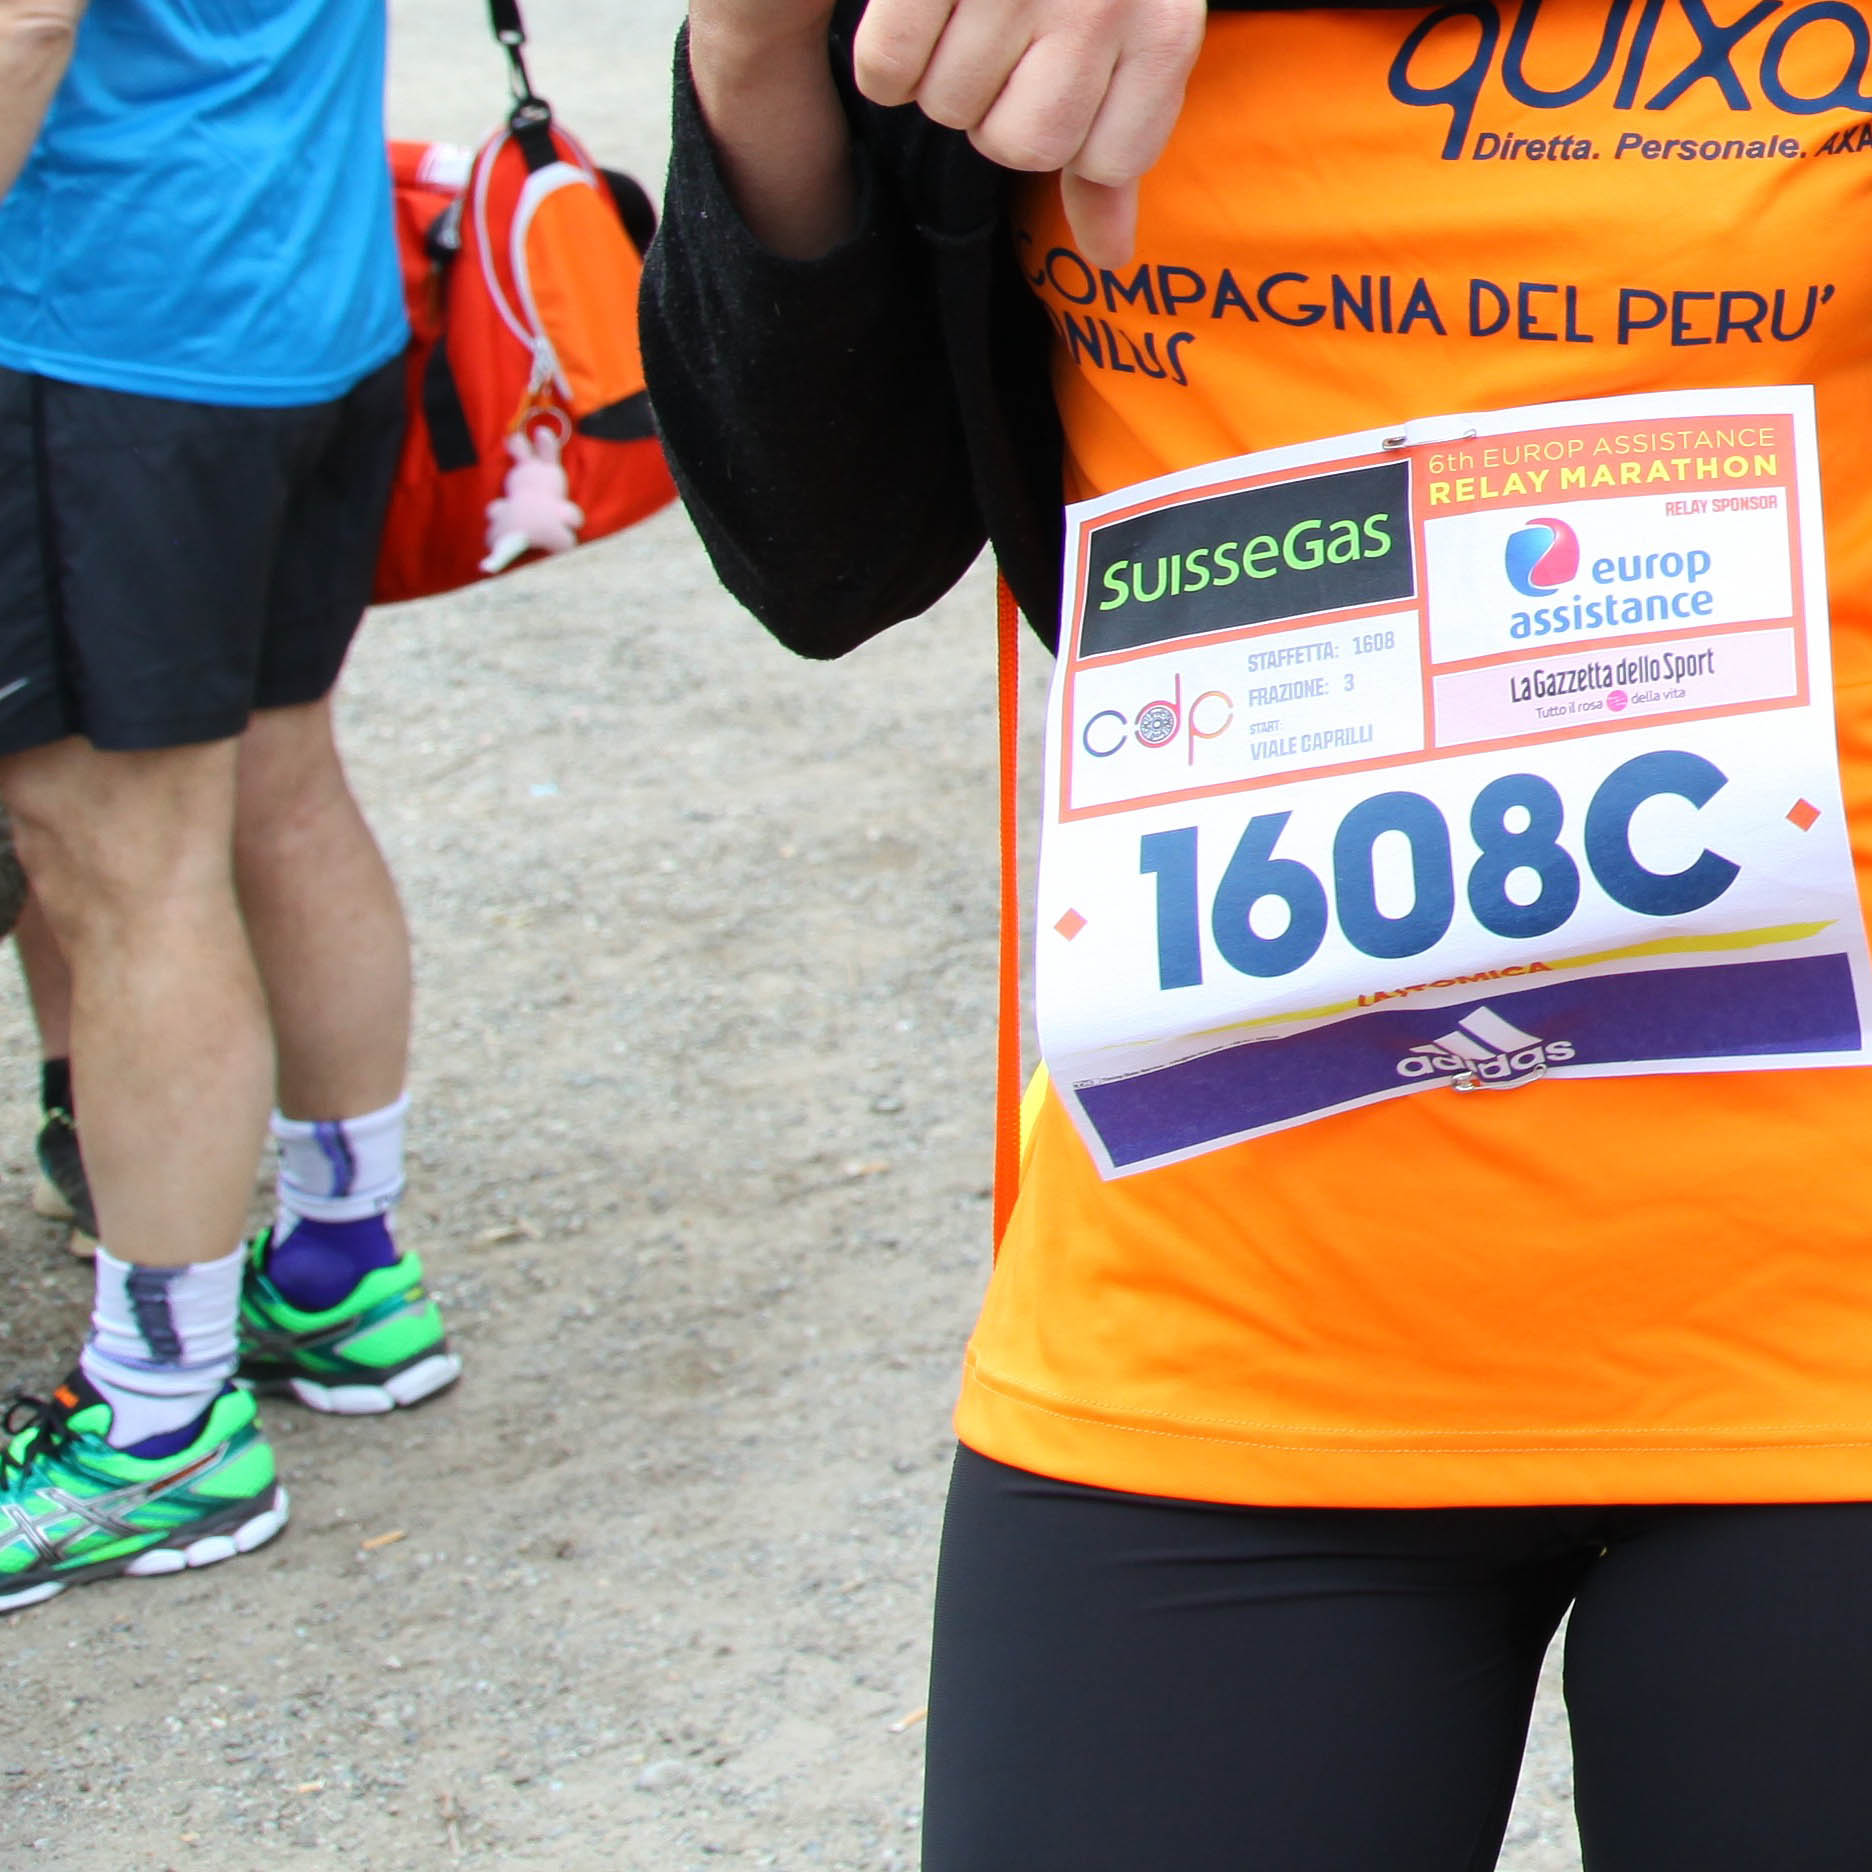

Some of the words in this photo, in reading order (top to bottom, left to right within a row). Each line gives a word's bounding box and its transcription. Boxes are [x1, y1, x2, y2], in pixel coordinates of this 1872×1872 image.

[1473, 131, 1600, 162] Diretta.
[1614, 132, 1806, 162] Personale.
[1469, 278, 1593, 343] DEL
[1617, 285, 1836, 348] PERU'
[1050, 306, 1196, 386] NLUS
[1428, 451, 1474, 474] 6th
[1483, 440, 1584, 469] EUROP
[1593, 428, 1776, 456] ASSISTANCE
[1429, 468, 1551, 506] RELAY
[1560, 454, 1777, 490] MARATHON
[1665, 499, 1708, 516] RELAY
[1711, 495, 1778, 513] SPONSOR
[1592, 548, 1713, 587] europ
[1509, 587, 1714, 640] assistance
[1248, 641, 1340, 673] STAFFETTA:
[1353, 631, 1395, 655] 1608
[1249, 678, 1329, 707] FRAZIONE:
[1344, 673, 1354, 692] 3
[1510, 677, 1531, 703] La
[1534, 662, 1613, 698] Gazzetta
[1616, 655, 1660, 686] dello
[1663, 648, 1715, 684] Sport
[1536, 705, 1567, 719] Tutto
[1578, 701, 1603, 713] rosa
[1631, 690, 1660, 704] della
[1663, 688, 1686, 699] vita
[1250, 736, 1297, 761] VIALE
[1301, 724, 1373, 753] CAPRILLI
[1139, 749, 1742, 991] 1608C
[1397, 1040, 1576, 1079] adidas
